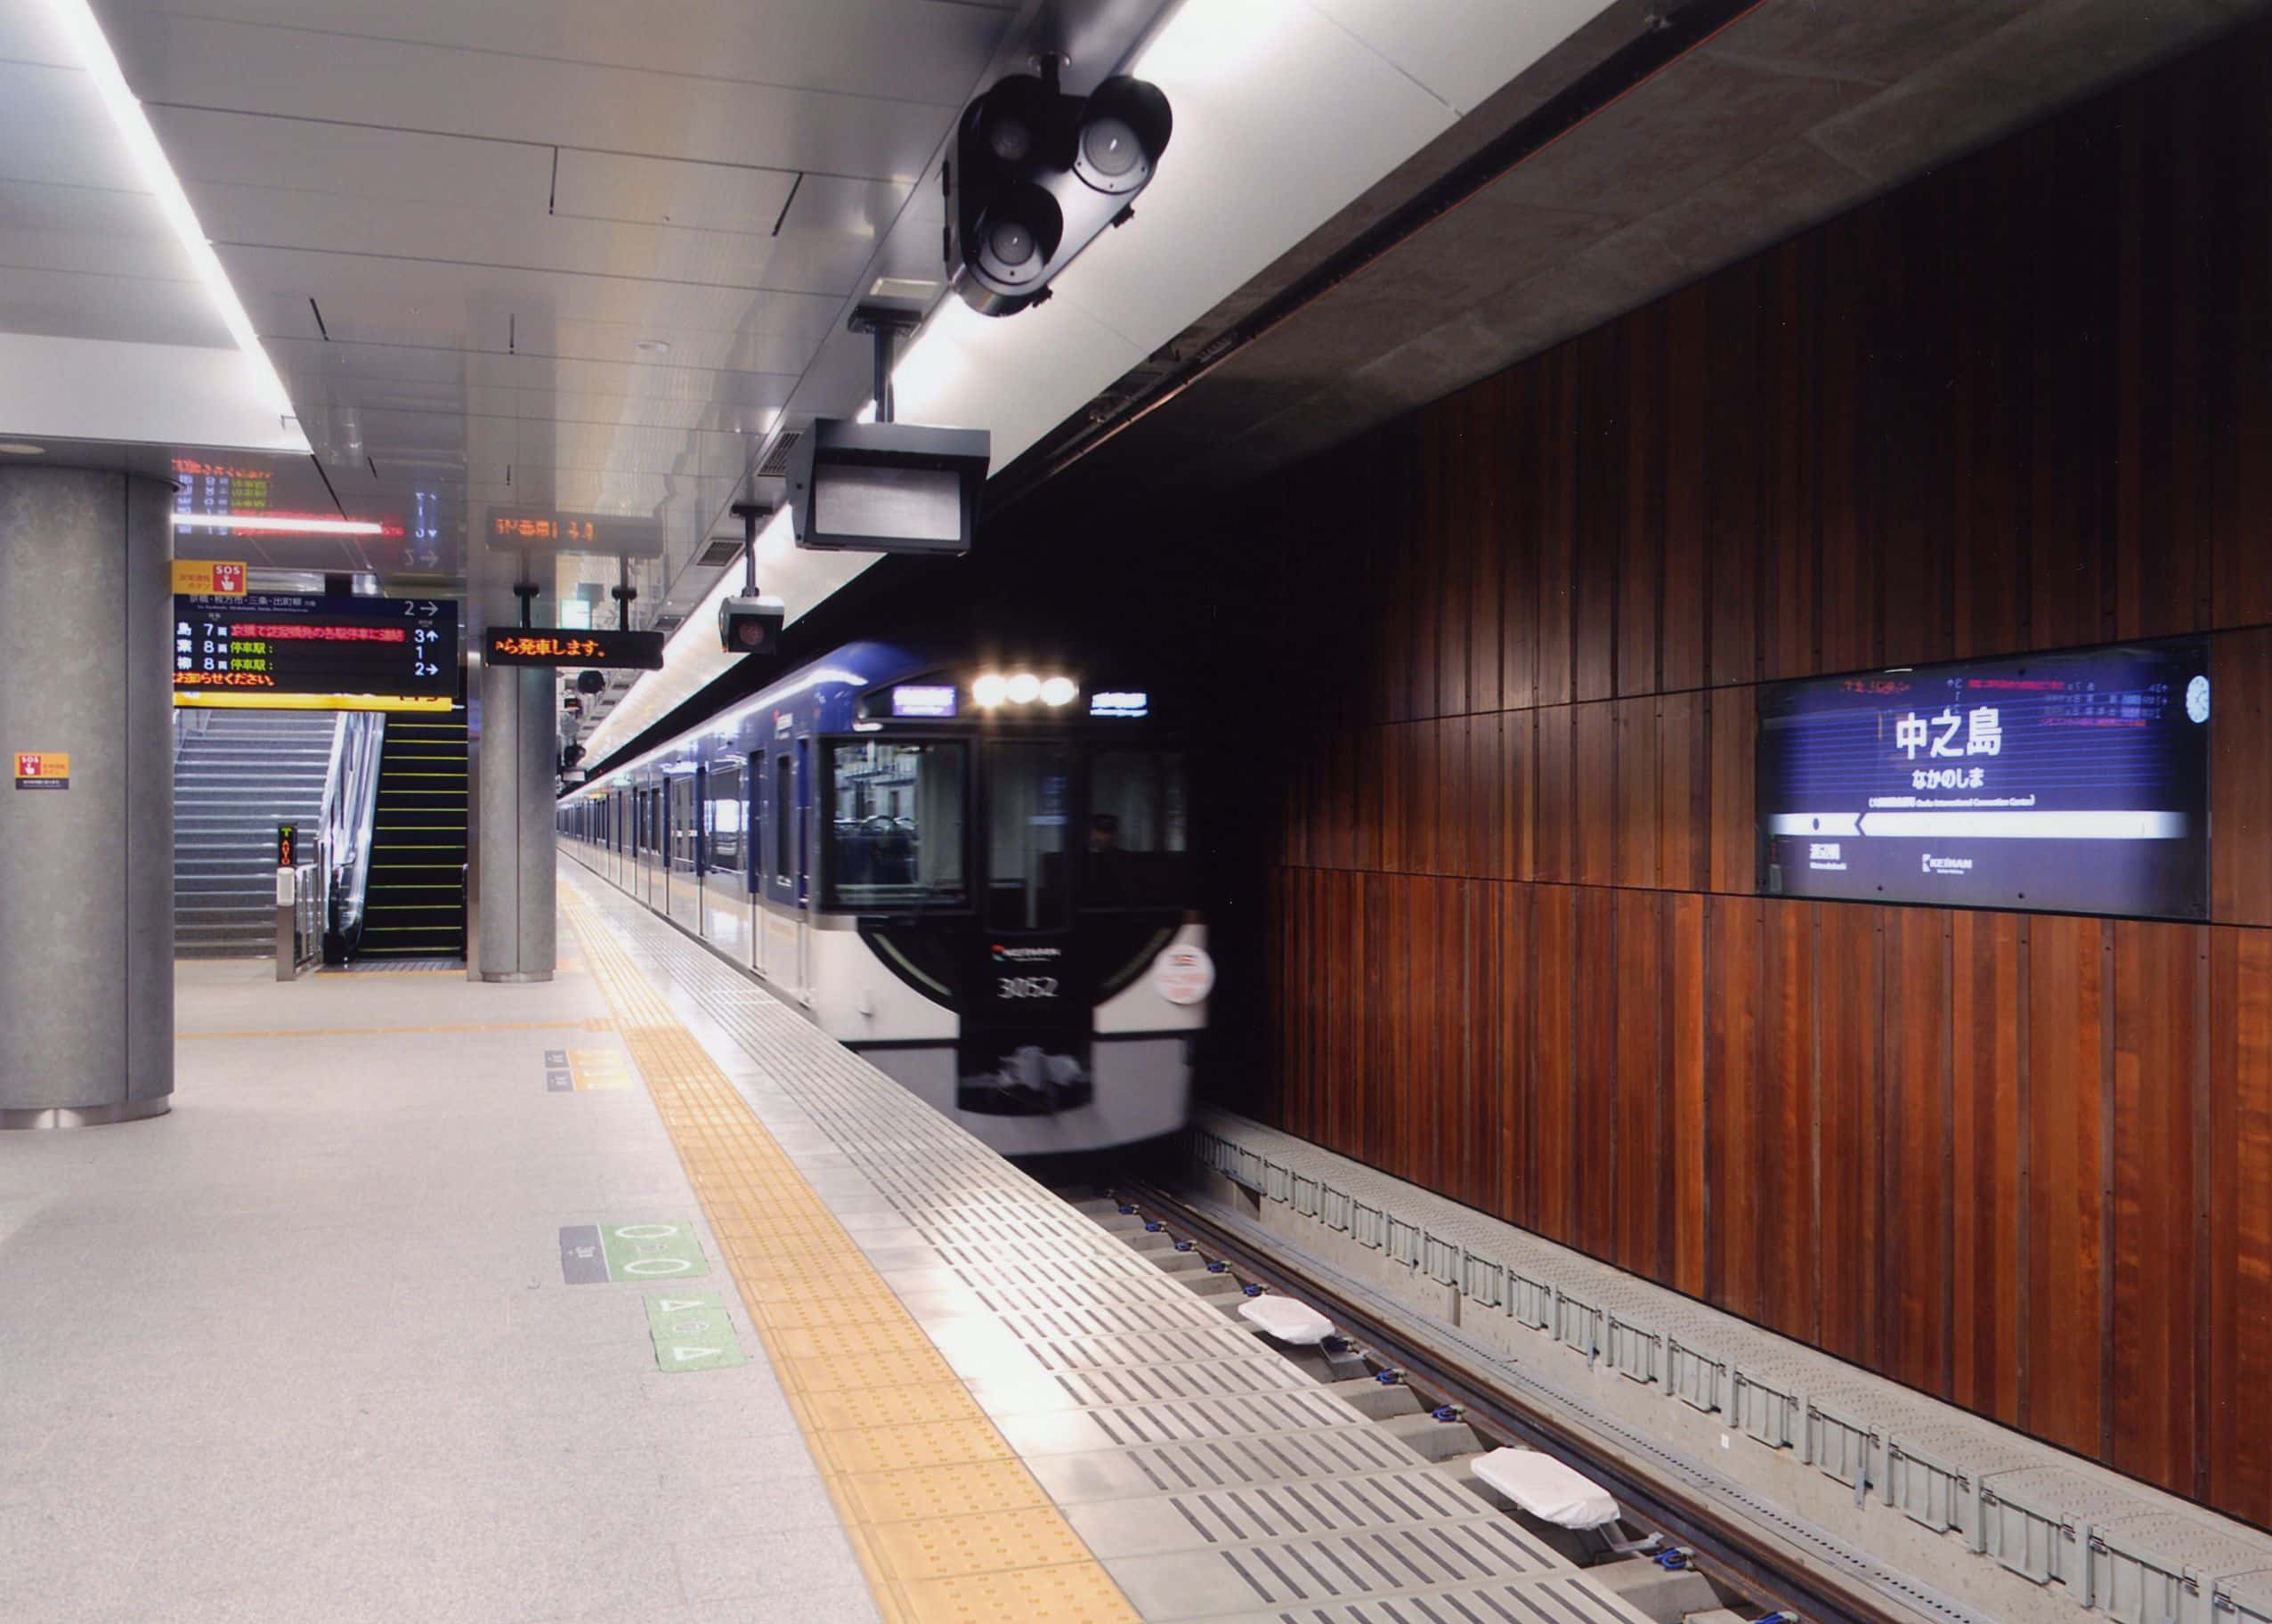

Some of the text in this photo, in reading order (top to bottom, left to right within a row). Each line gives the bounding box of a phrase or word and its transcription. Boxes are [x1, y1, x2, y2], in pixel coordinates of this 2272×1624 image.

[215, 565, 241, 574] SOS
[404, 601, 415, 615] 2
[414, 629, 425, 643] 3
[416, 646, 424, 660] 1
[414, 662, 425, 676] 2
[1895, 706, 2002, 759] 中之島
[1911, 767, 1985, 790] なかのしま
